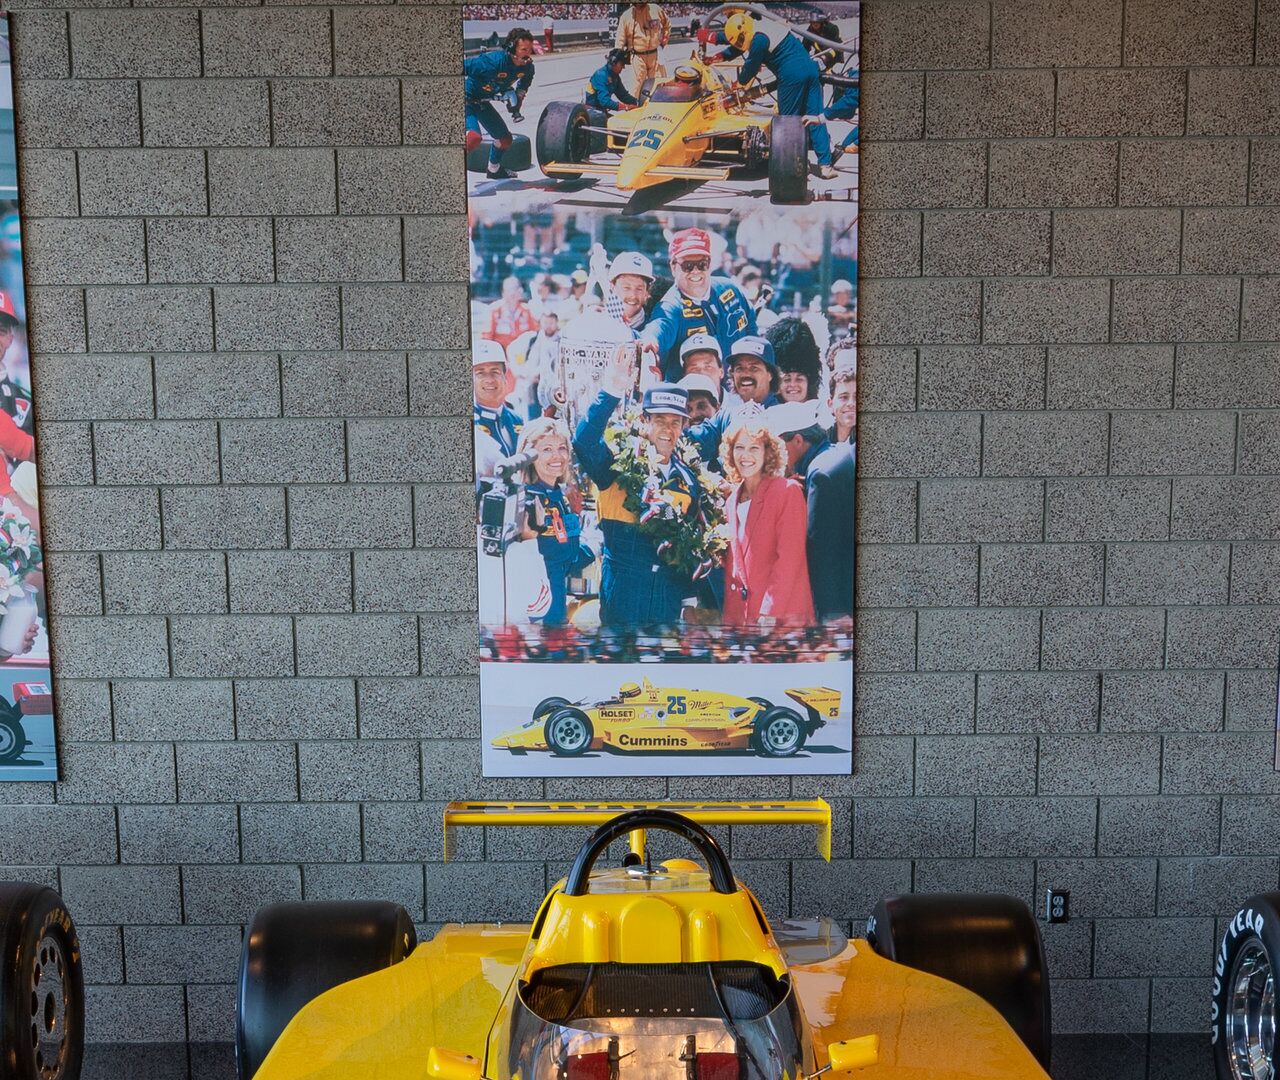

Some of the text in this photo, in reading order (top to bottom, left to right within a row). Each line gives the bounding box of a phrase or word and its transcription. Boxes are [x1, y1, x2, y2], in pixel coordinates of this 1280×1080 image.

[608, 18, 619, 28] 32
[627, 128, 665, 151] 25
[667, 695, 687, 715] 25
[688, 699, 714, 710] Miller
[600, 710, 634, 718] HOLSET
[829, 707, 840, 718] 25
[619, 734, 688, 747] Cummins
